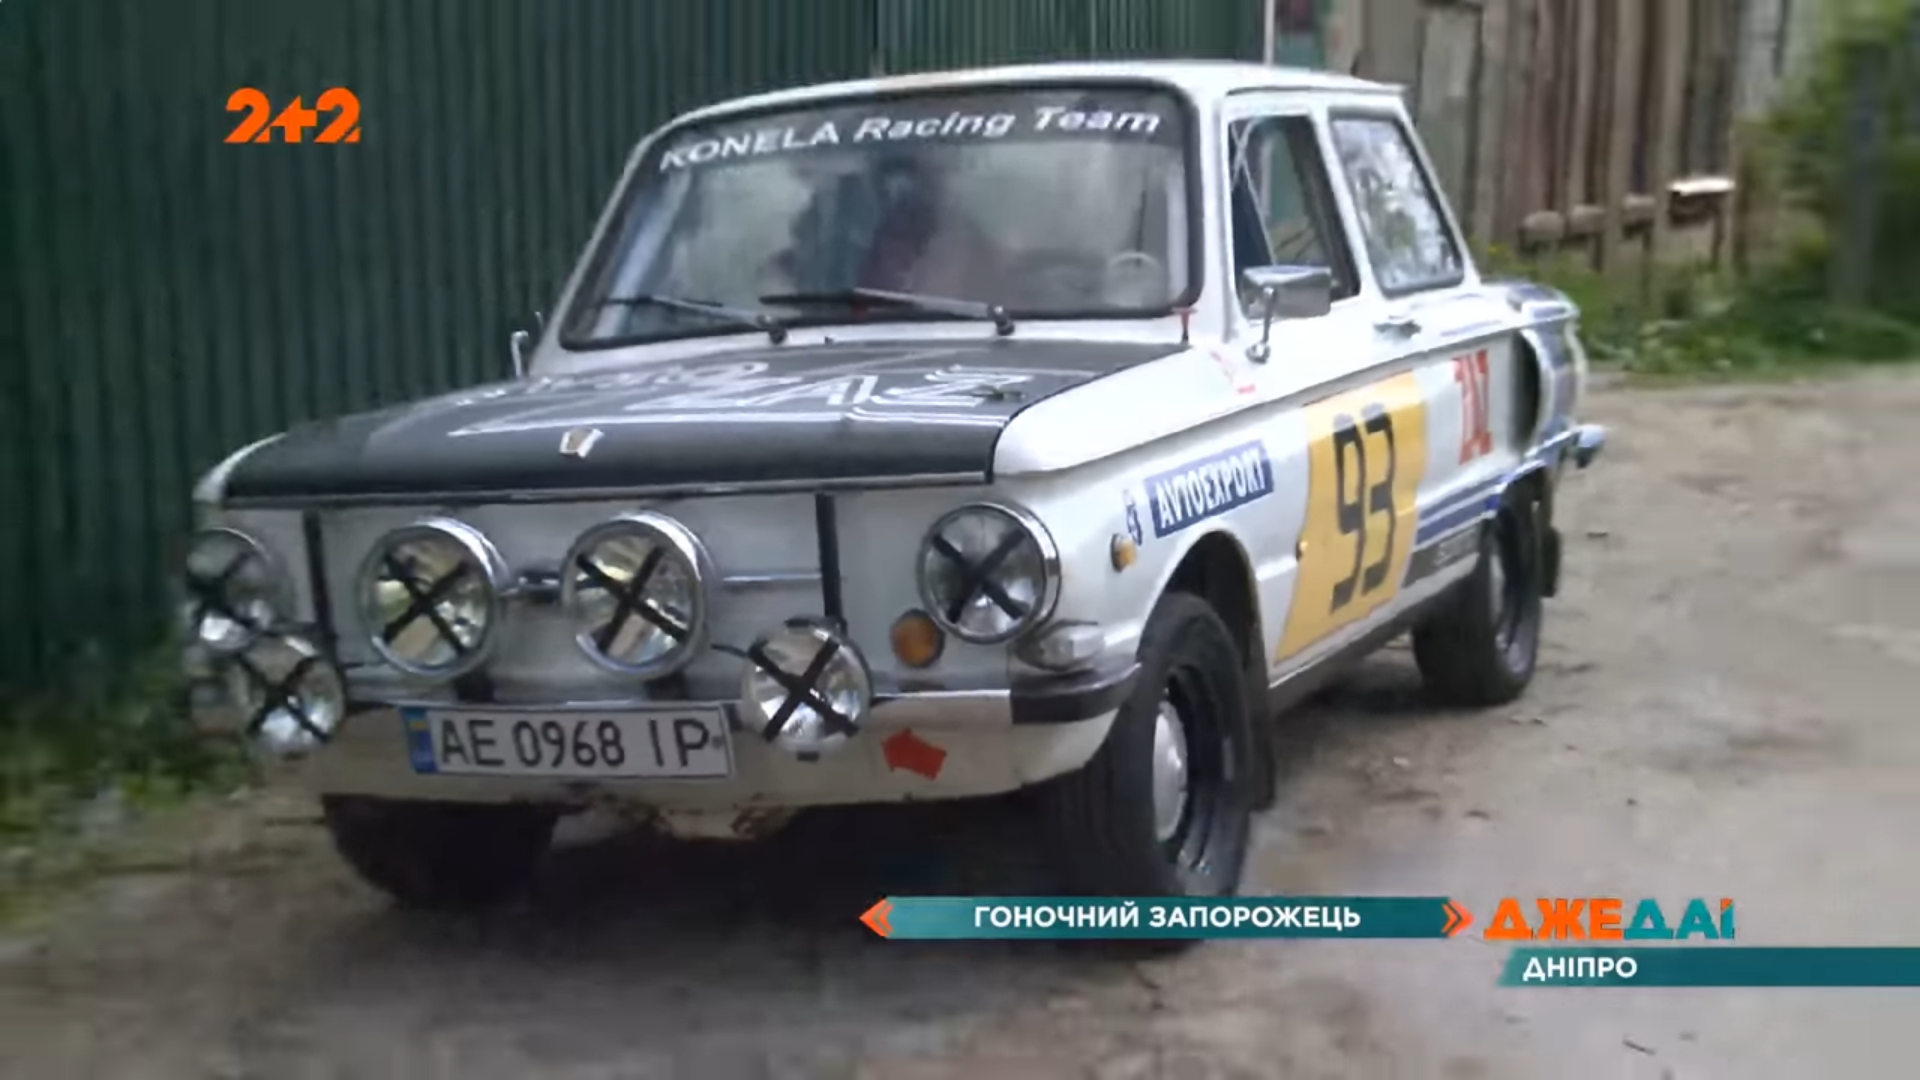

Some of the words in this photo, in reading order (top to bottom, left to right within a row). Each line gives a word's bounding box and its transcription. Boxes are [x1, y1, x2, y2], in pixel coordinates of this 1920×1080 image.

[659, 121, 840, 171] KONELA
[853, 111, 1016, 143] Racing
[1034, 106, 1160, 133] Team
[1155, 447, 1266, 529] AVTOEXPORT
[1329, 403, 1396, 616] 93
[440, 718, 505, 766] AE
[511, 719, 625, 768] 0968
[649, 717, 709, 768] IP
